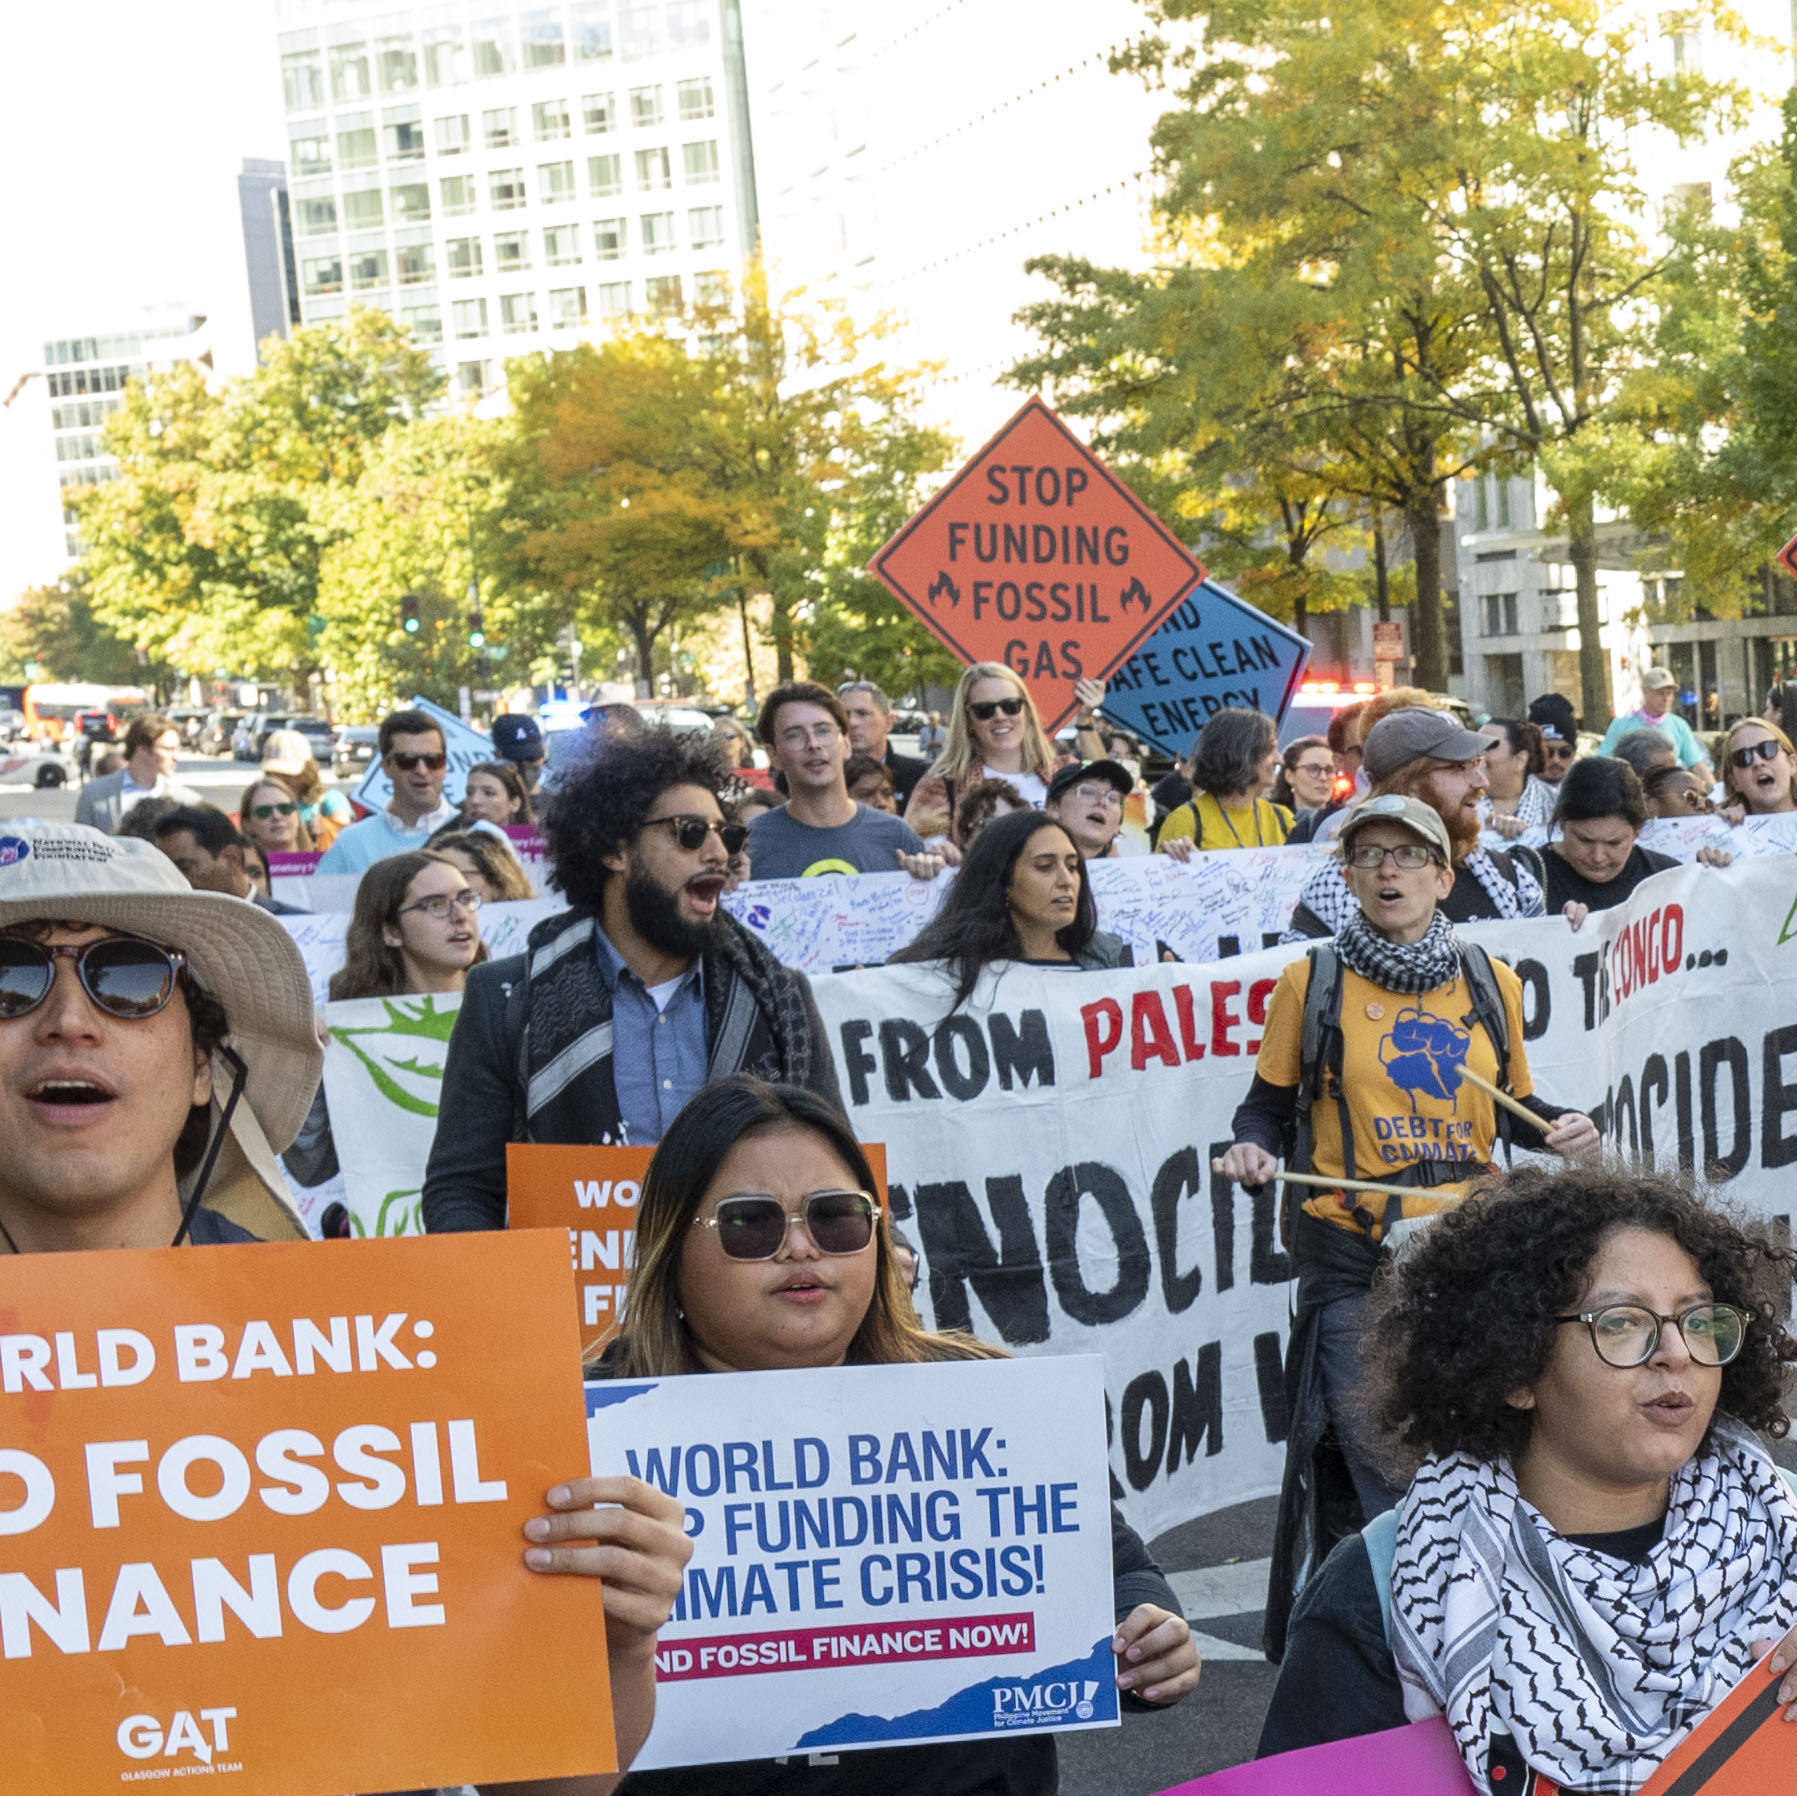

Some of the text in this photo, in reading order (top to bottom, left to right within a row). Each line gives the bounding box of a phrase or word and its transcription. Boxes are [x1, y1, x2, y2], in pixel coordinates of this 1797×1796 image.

[987, 464, 1089, 507] STOP
[948, 522, 1130, 568] FUNDING
[972, 581, 1110, 624] FOSSIL
[1003, 639, 1084, 681] GAS
[1105, 652, 1171, 694] AFE
[1172, 634, 1281, 682] CLEAN
[840, 1009, 1055, 1107] FROM
[1373, 1116, 1473, 1141] DEBT FOR
[173, 1312, 438, 1383] BANK:
[1104, 1339, 1224, 1500] OM
[84, 1418, 508, 1529] FOSSIL
[626, 1426, 1007, 1499] WORLD BANK:
[725, 1488, 961, 1557] FUNDING
[976, 1481, 1081, 1539] THE
[666, 1543, 1046, 1624] IMATE CRISIS!
[700, 1641, 807, 1672] FOSSIL
[812, 1628, 943, 1661] FINANCE
[947, 1621, 1030, 1649] NOW!
[116, 1706, 238, 1764] GAT
[216, 1761, 244, 1773] TEAM
